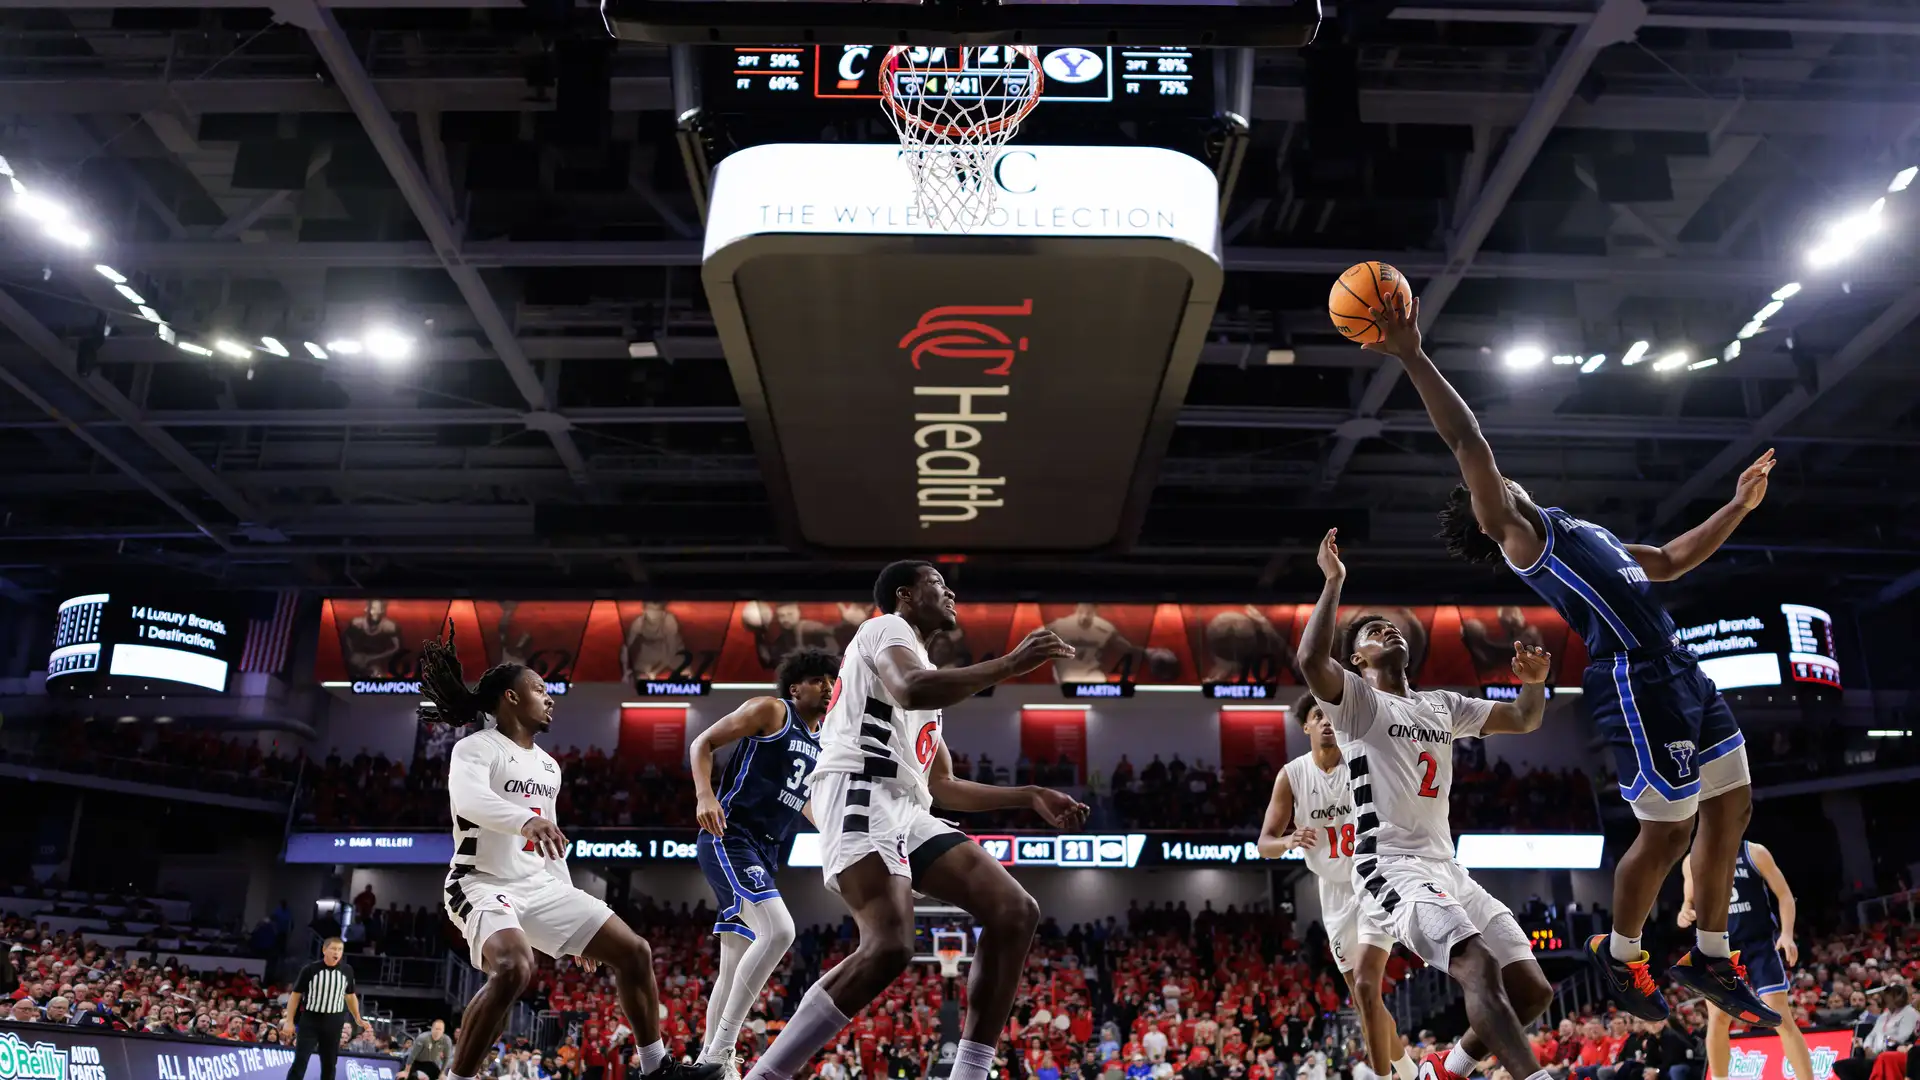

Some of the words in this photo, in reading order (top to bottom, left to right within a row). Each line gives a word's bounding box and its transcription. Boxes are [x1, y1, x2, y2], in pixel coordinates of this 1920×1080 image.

[737, 56, 759, 67] 3PT
[769, 54, 800, 68] 50%
[1055, 53, 1091, 78] Y
[1126, 60, 1148, 71] 3PT
[1158, 58, 1188, 72] 20%
[736, 78, 751, 90] FT
[769, 77, 799, 90] 60%
[1126, 83, 1140, 94] FT
[1160, 81, 1188, 95] 75%
[760, 205, 815, 226] THE
[835, 205, 940, 226] WYLER
[961, 206, 1176, 229] COLLECTION
[132, 605, 146, 619] 14
[146, 607, 187, 627] Luxury
[188, 613, 227, 635] Brands.
[1681, 623, 1717, 641] Luxury
[1719, 616, 1764, 633] Brands.
[139, 624, 145, 637] 1
[148, 625, 216, 650] Destination.
[353, 681, 422, 693] CHAMPIONS
[646, 682, 702, 695] TWYMAN
[1075, 684, 1122, 697] MARTIN
[1213, 685, 1250, 697] SWEET
[1252, 685, 1266, 697] 16
[1486, 686, 1518, 698] FINAL
[787, 739, 821, 761] BRIGH
[1417, 751, 1439, 798] 2
[576, 840, 642, 858] Brands.
[1323, 823, 1355, 858] 18
[1065, 841, 1088, 860] 21
[1162, 842, 1182, 860] 14
[1184, 842, 1241, 863] Luxury
[71, 1046, 100, 1064] AUTO
[157, 1054, 186, 1079] ALL
[187, 1052, 241, 1080] ACROSS
[238, 1047, 264, 1073] THE
[263, 1047, 295, 1068] NATIO
[69, 1064, 107, 1080] PARTS
